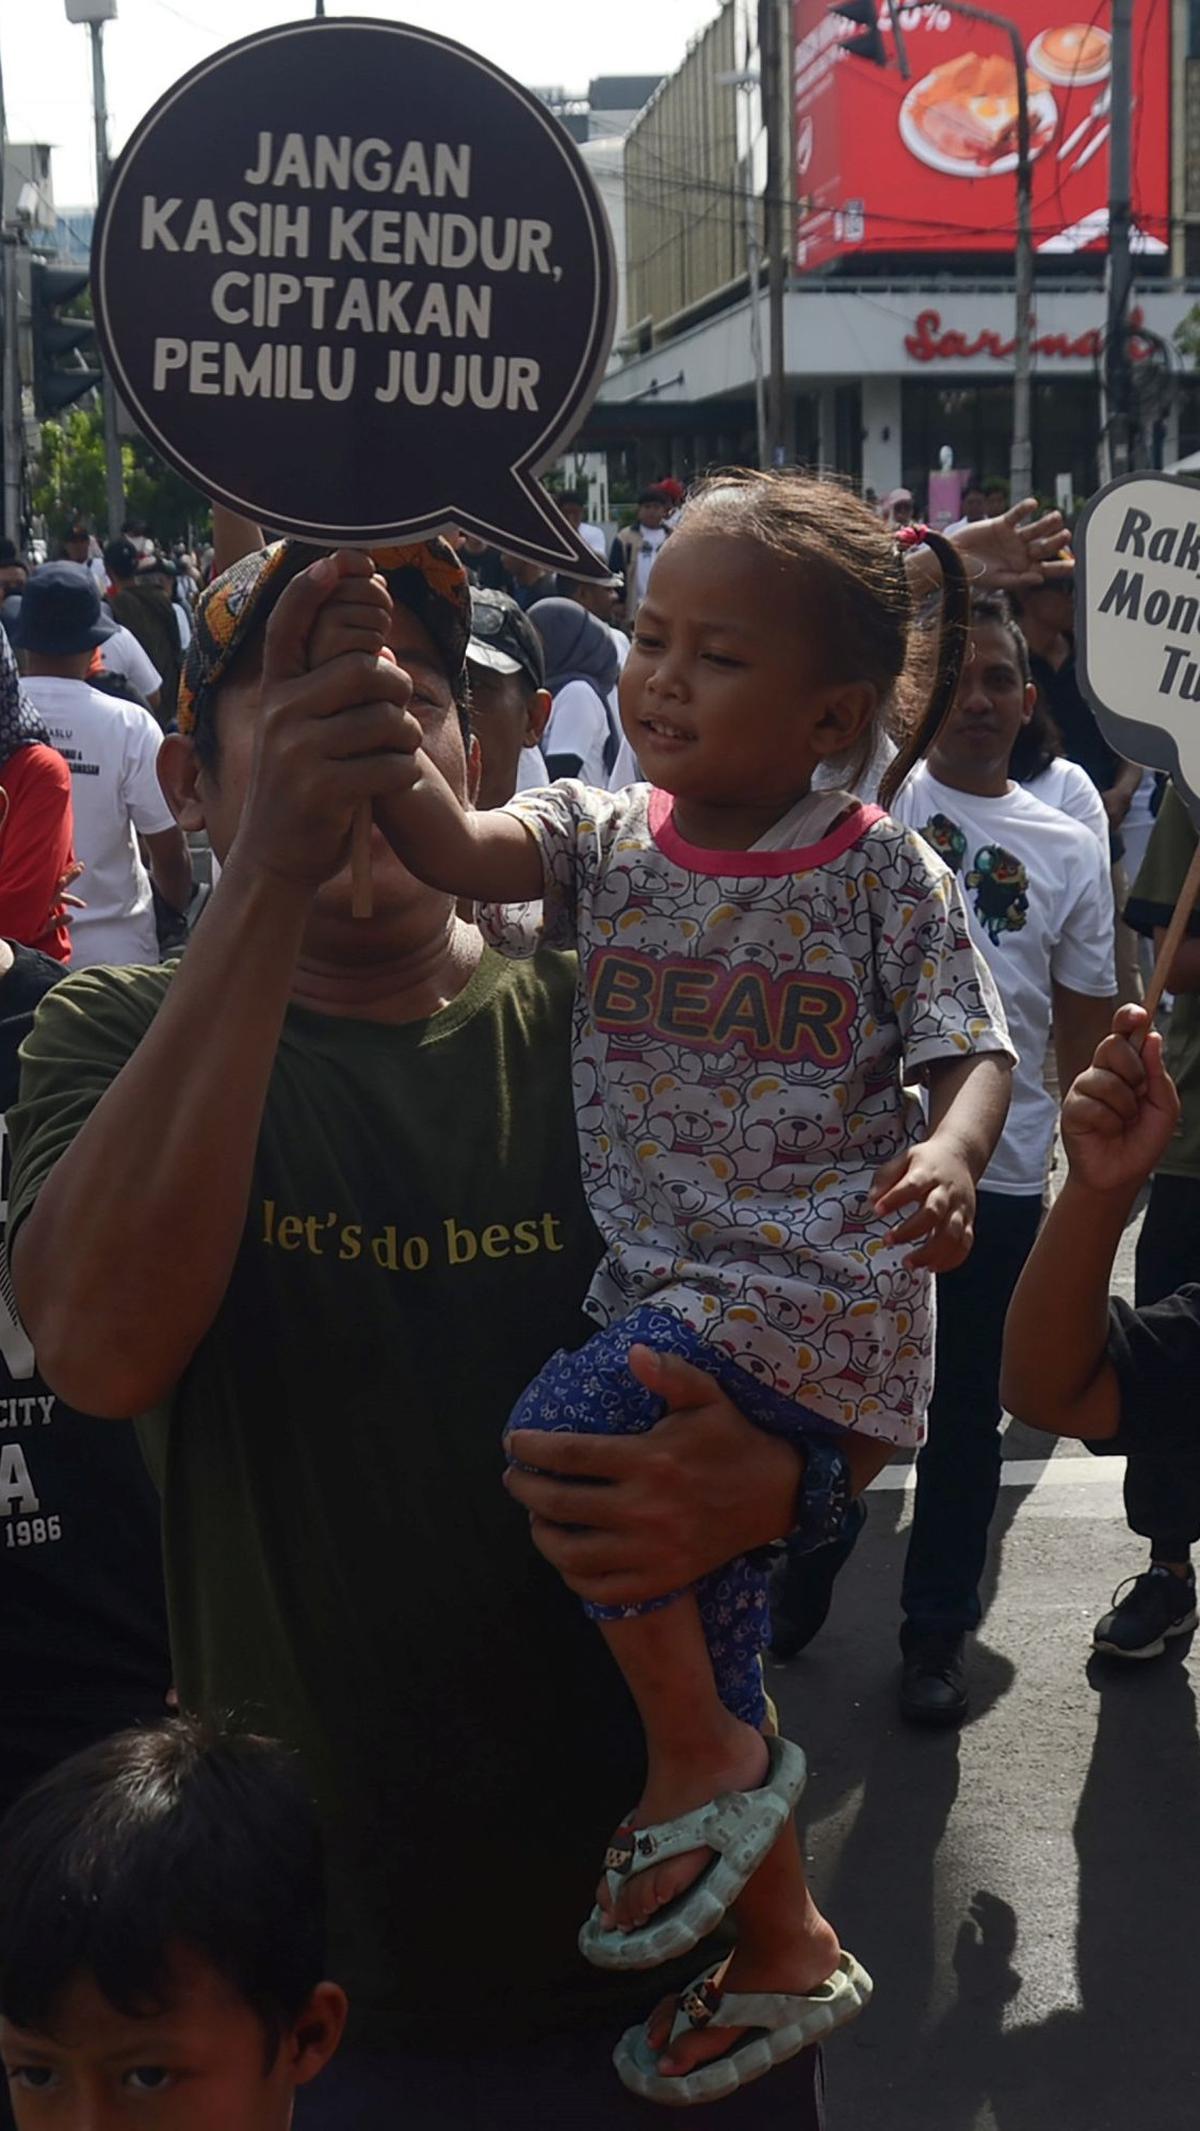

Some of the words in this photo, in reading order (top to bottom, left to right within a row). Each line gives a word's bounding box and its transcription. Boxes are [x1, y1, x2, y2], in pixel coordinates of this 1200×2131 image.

[244, 131, 471, 199] JANGAN
[141, 196, 309, 258] KASIH
[329, 207, 563, 282] KENDUR,
[211, 271, 491, 338] CIPTAKAN
[152, 338, 356, 401] PEMILU
[375, 350, 540, 411] JUJUR
[1115, 506, 1200, 579] Rak
[1098, 568, 1200, 635] Mon
[593, 954, 847, 1060] BEAR
[262, 1200, 362, 1260] let's
[371, 1226, 429, 1271] do
[443, 1212, 564, 1264] best
[5, 1515, 62, 1548] 1986
